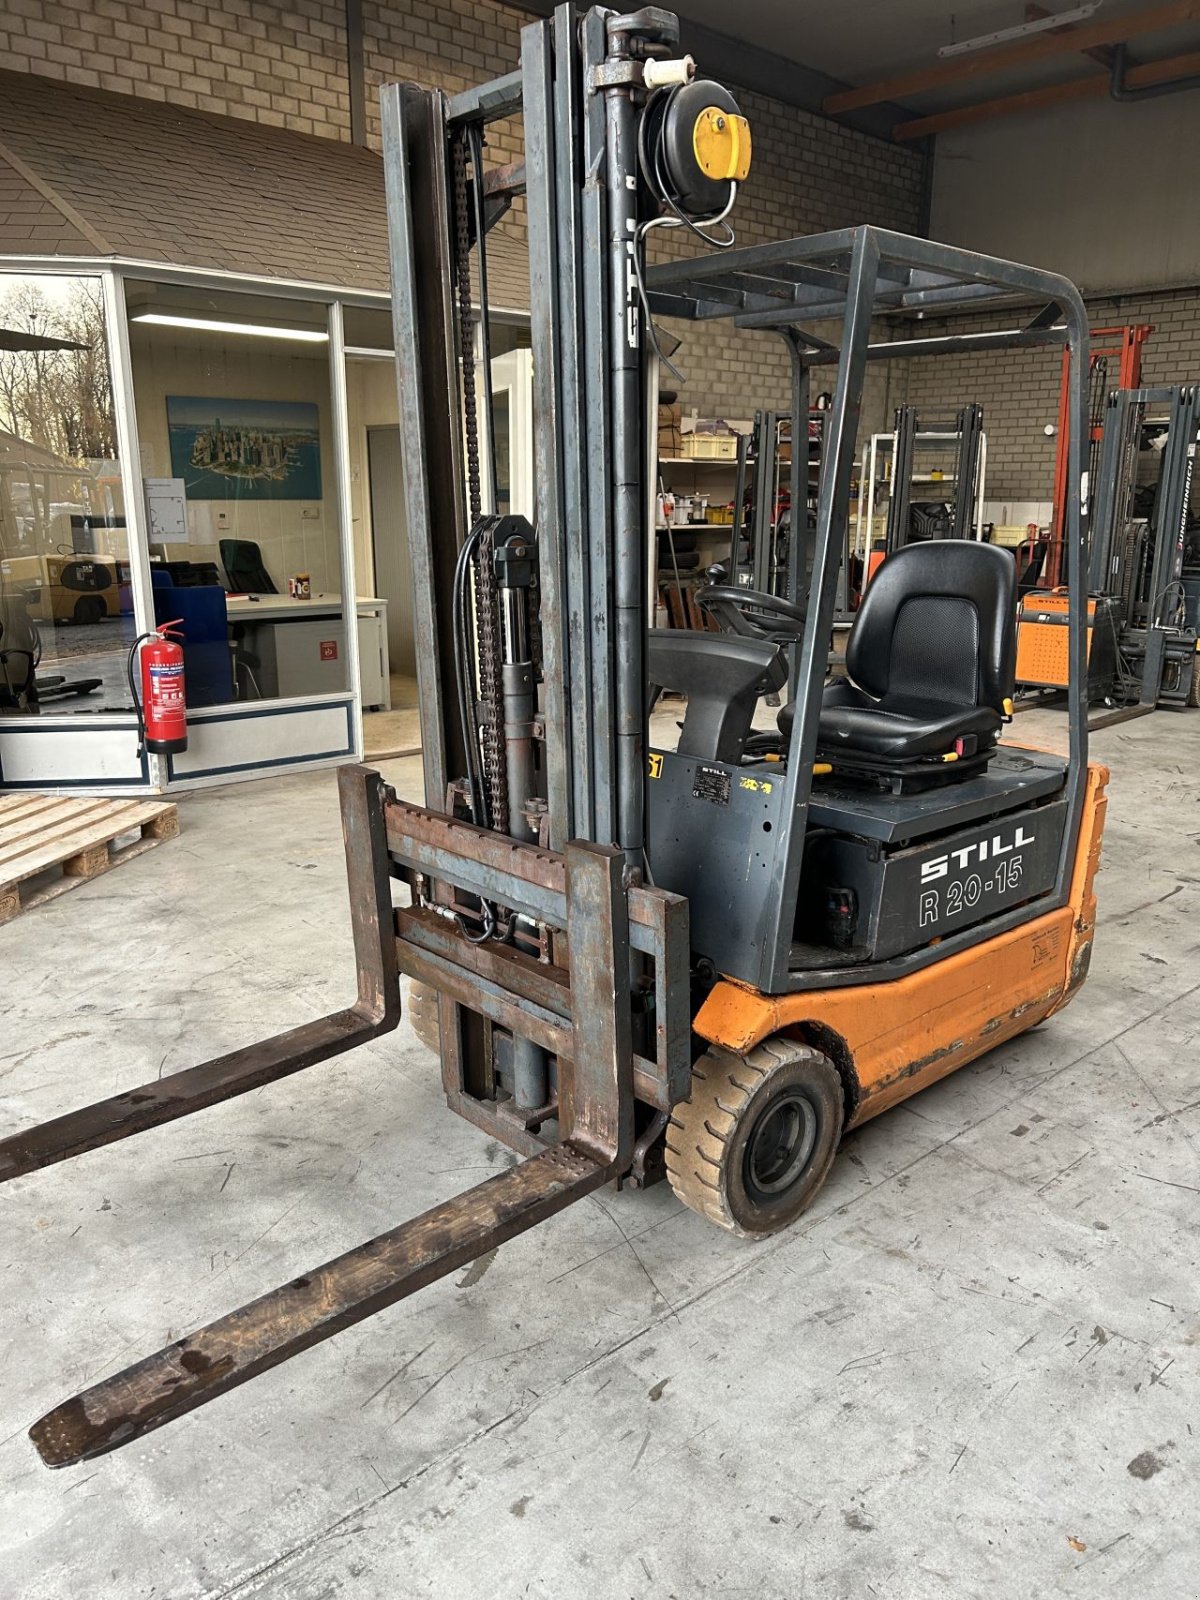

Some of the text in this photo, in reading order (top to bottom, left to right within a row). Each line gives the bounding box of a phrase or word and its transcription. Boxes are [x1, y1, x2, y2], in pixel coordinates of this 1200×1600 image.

[1177, 460, 1193, 551] JUNGHEINRICH
[702, 767, 727, 776] STILL
[920, 826, 1035, 885] STILL
[919, 855, 1023, 928] R 20-15
